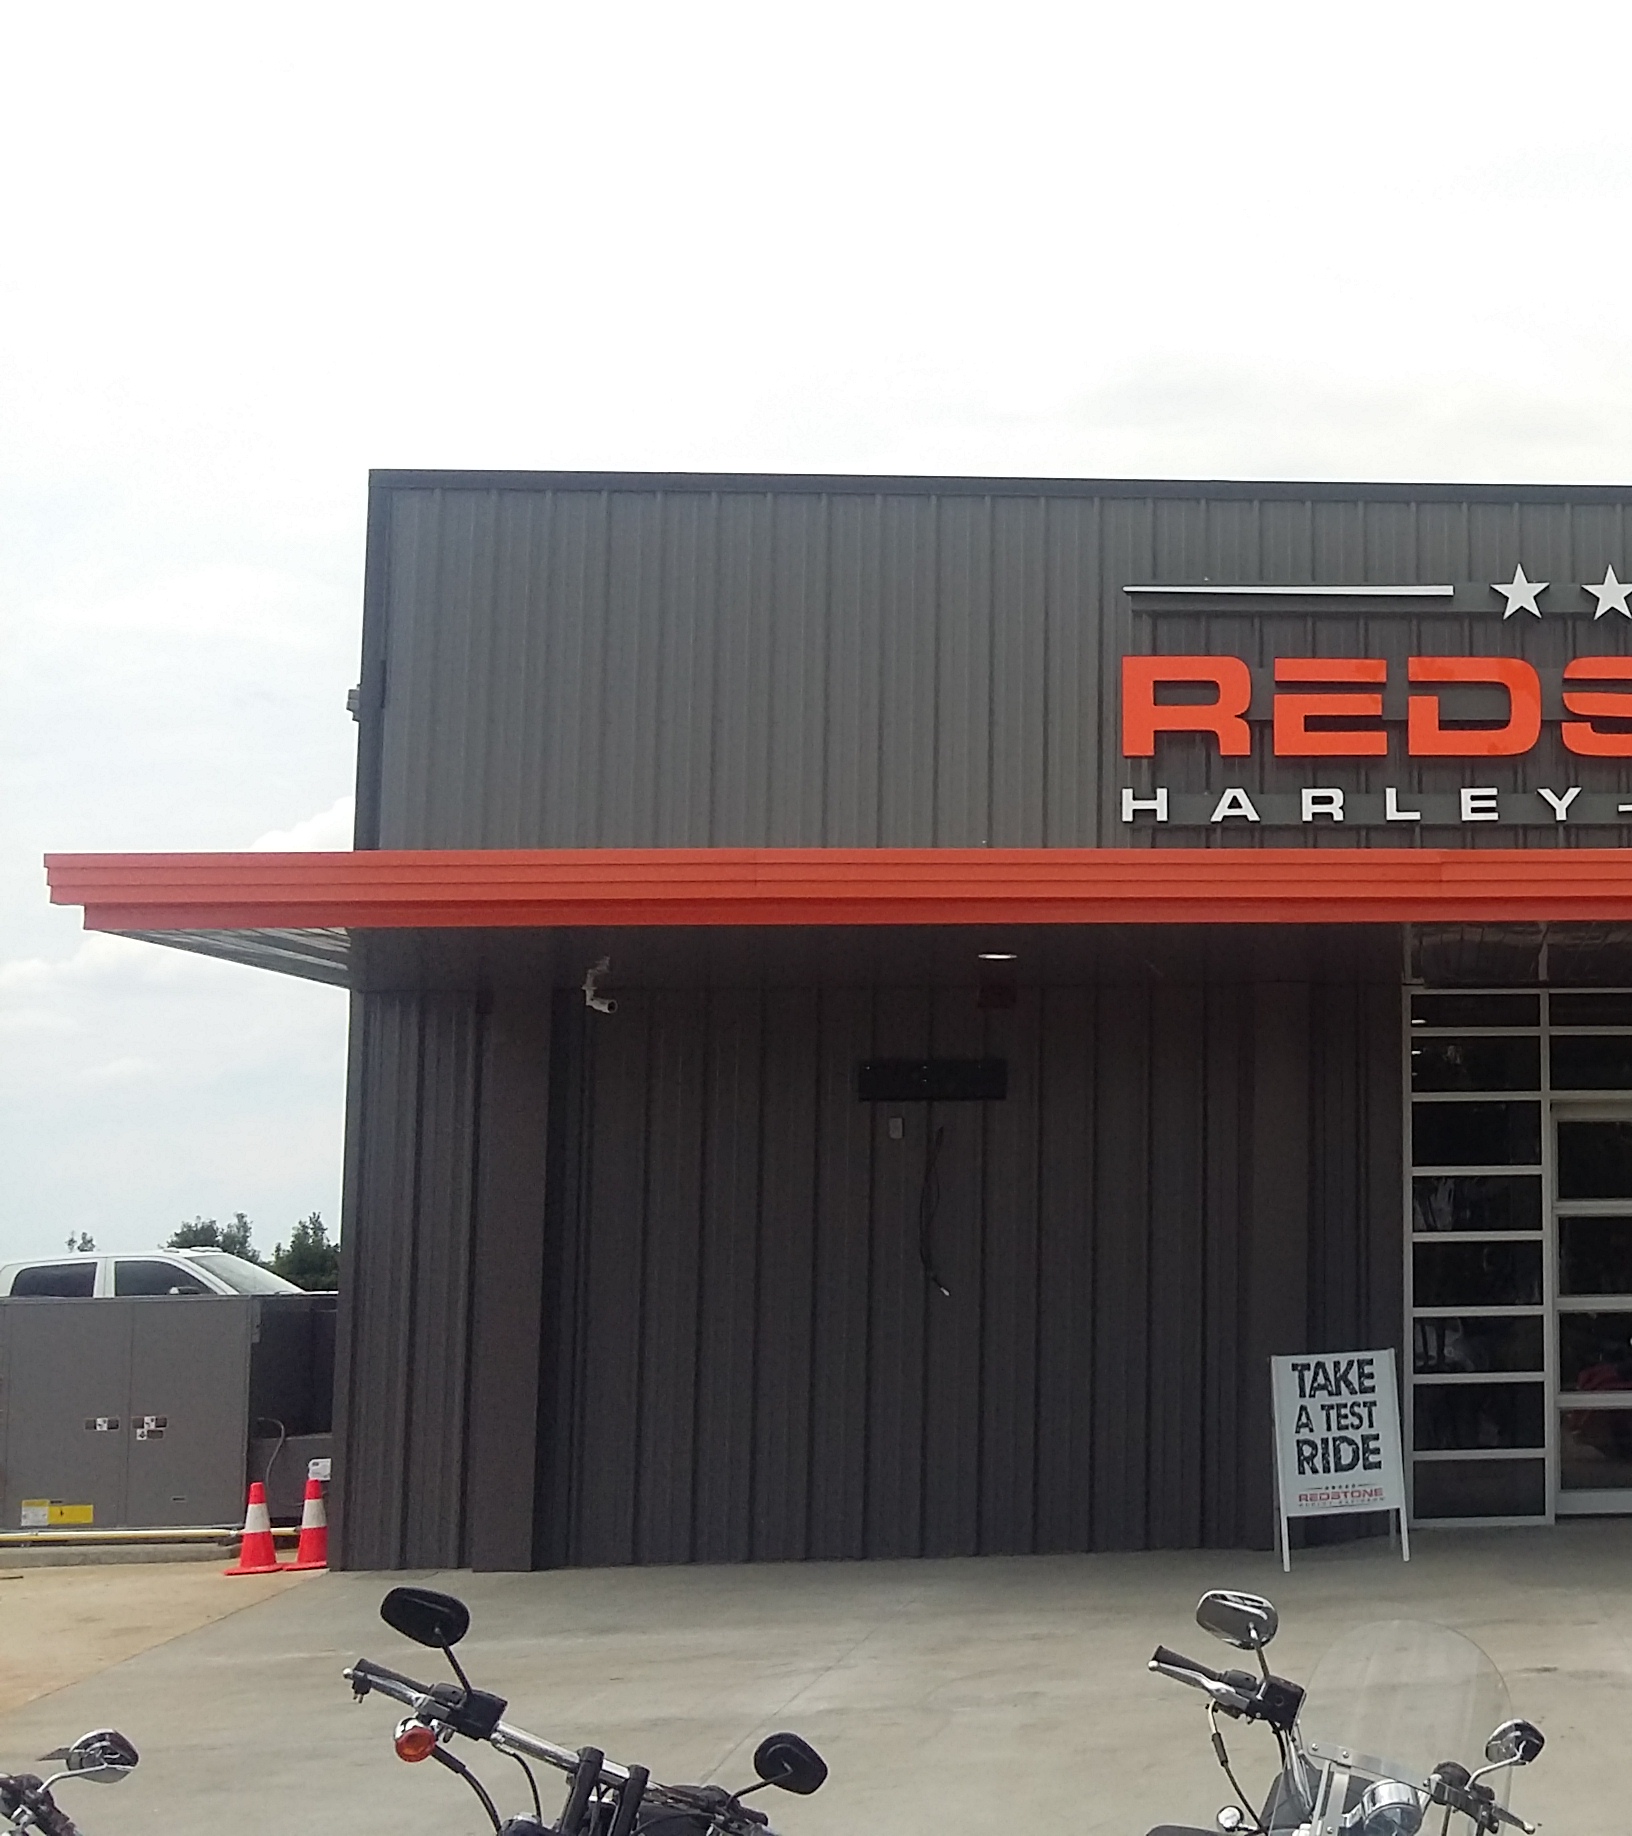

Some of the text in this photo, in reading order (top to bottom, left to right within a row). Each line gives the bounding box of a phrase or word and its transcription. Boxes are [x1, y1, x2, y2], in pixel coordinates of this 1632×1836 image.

[1291, 1358, 1376, 1399] TAKE
[1294, 1400, 1378, 1434] A TEST
[1296, 1433, 1383, 1475] RIDE
[1298, 1487, 1384, 1503] REDSTONE
